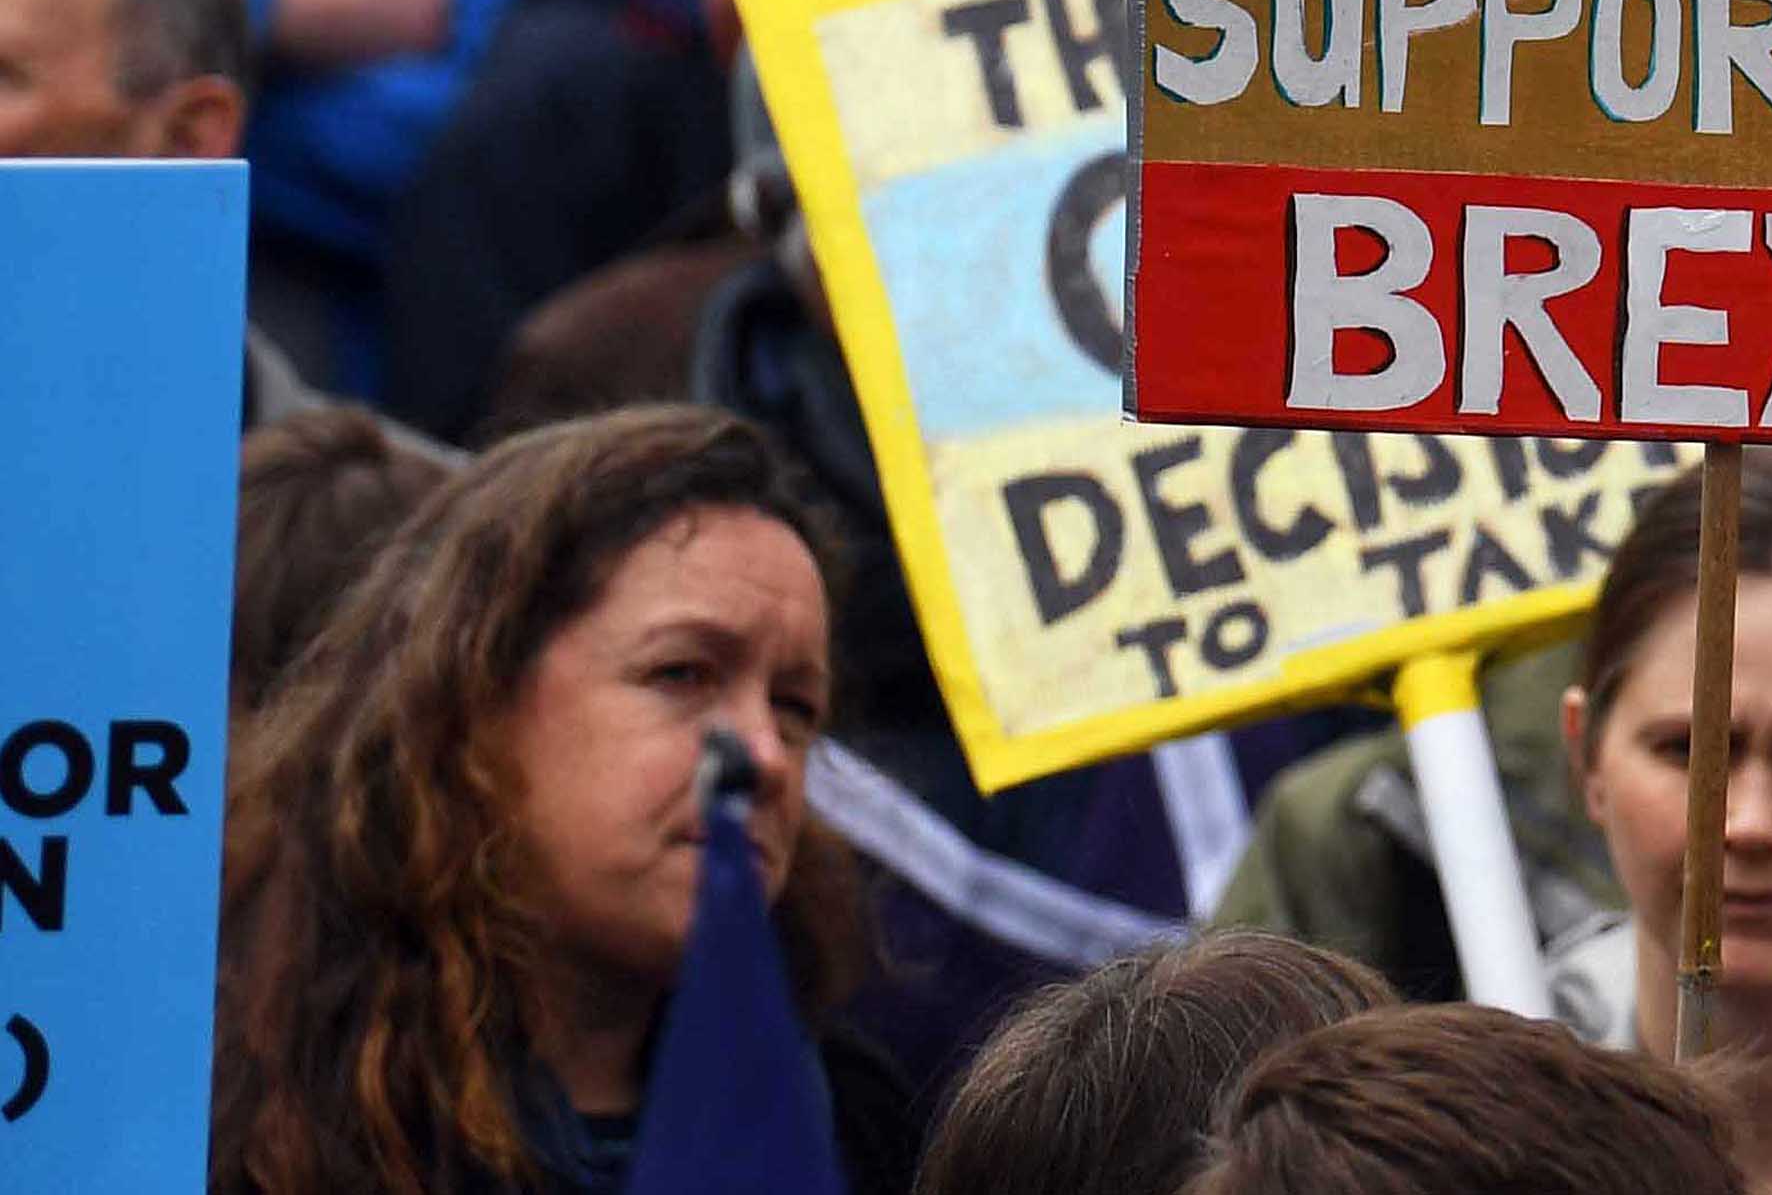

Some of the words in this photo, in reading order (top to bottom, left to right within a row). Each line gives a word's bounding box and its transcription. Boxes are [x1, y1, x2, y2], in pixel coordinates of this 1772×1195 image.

[1004, 424, 1678, 626] DECI
[1117, 602, 1268, 700] TO
[0, 718, 190, 821] OR
